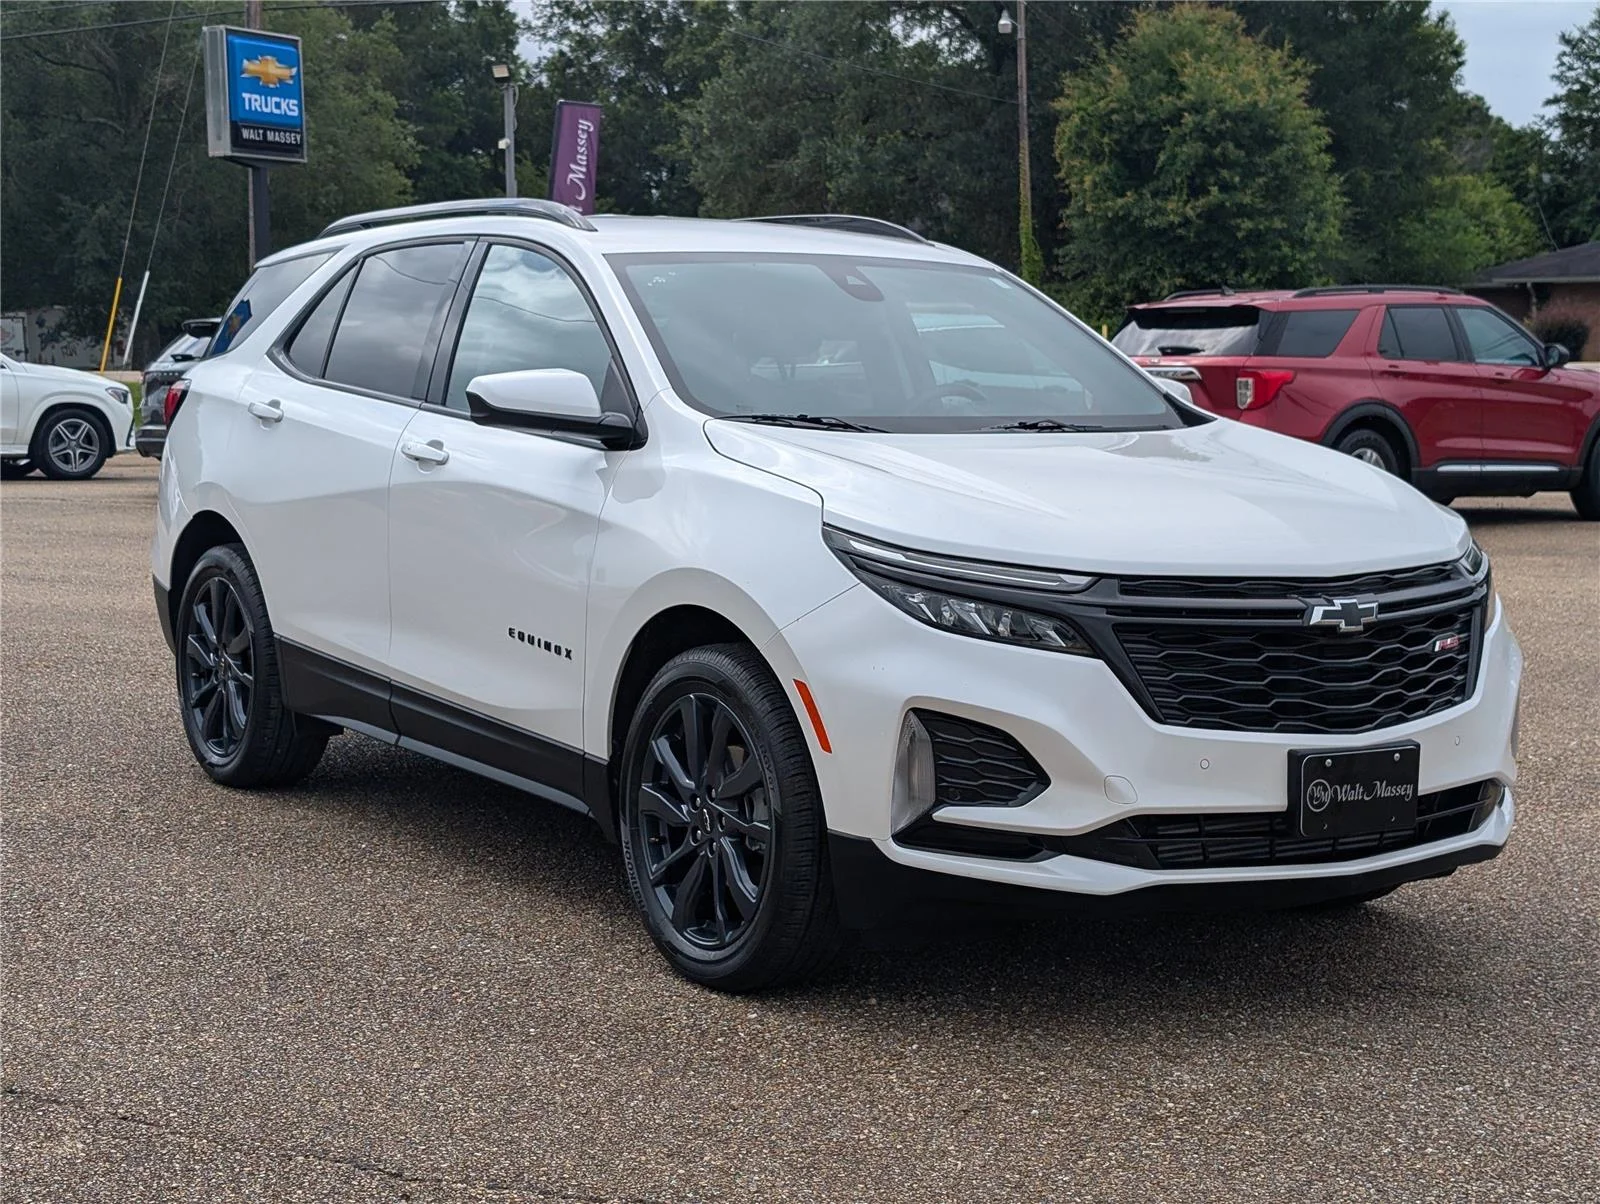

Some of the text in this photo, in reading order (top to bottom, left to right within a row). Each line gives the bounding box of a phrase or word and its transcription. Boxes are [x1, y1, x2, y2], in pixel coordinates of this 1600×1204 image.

[241, 92, 299, 117] TRUCKS
[241, 128, 301, 145] WALT MASSEY
[566, 119, 594, 201] Massey
[508, 627, 572, 660] EQUINOX
[1330, 780, 1414, 802] Walt Massey
